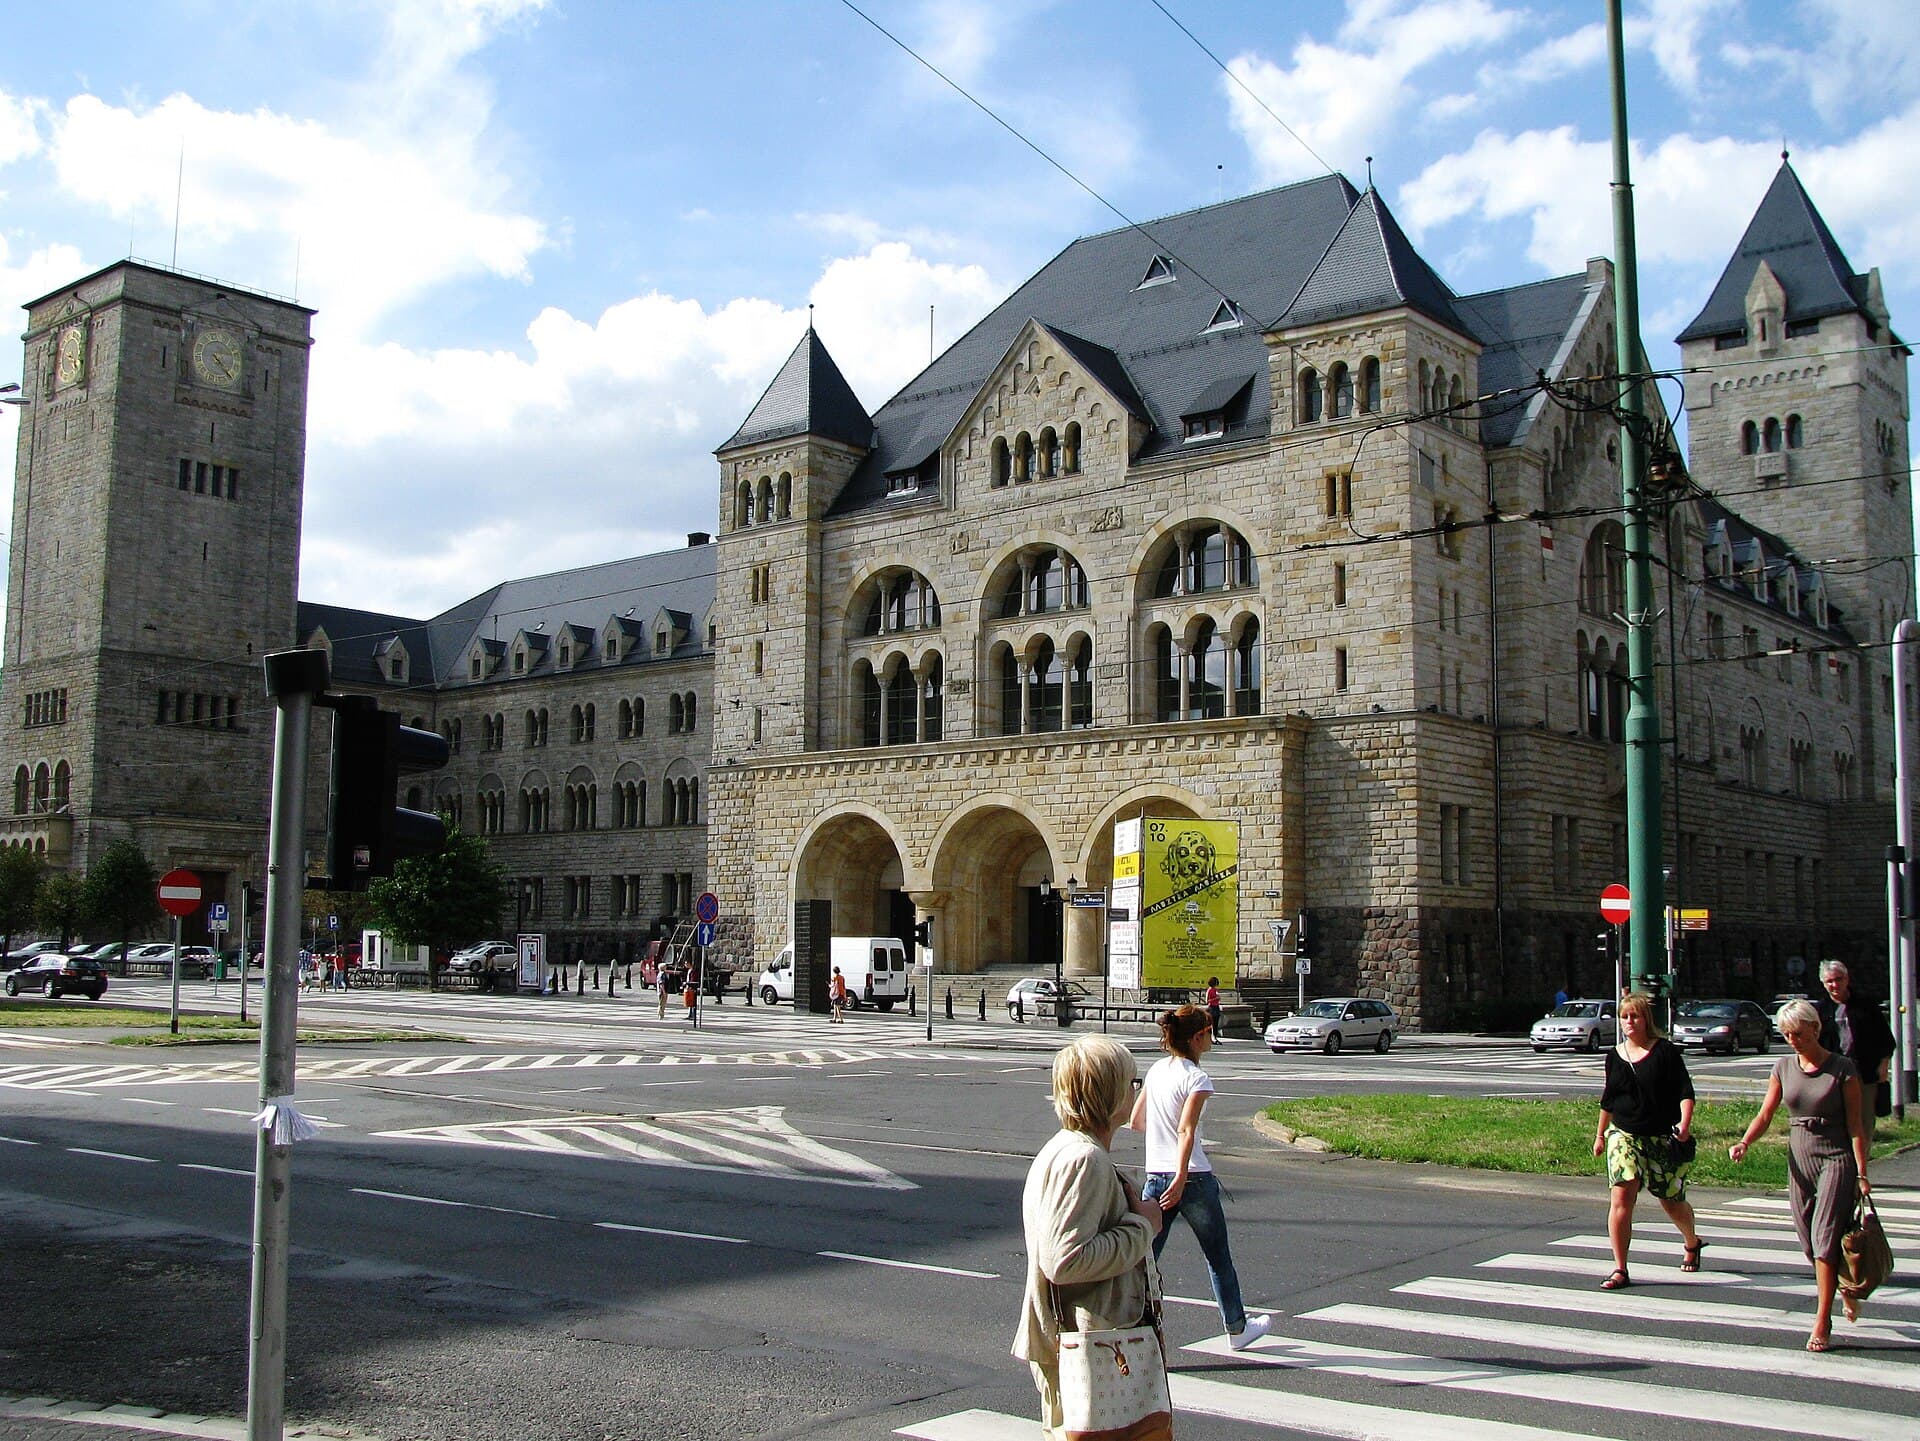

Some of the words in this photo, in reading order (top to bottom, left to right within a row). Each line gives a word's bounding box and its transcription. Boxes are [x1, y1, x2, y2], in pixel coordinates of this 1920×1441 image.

[1149, 822, 1168, 832] 07.
[1150, 833, 1165, 842] 10
[215, 905, 225, 918] P
[329, 915, 337, 928] P
